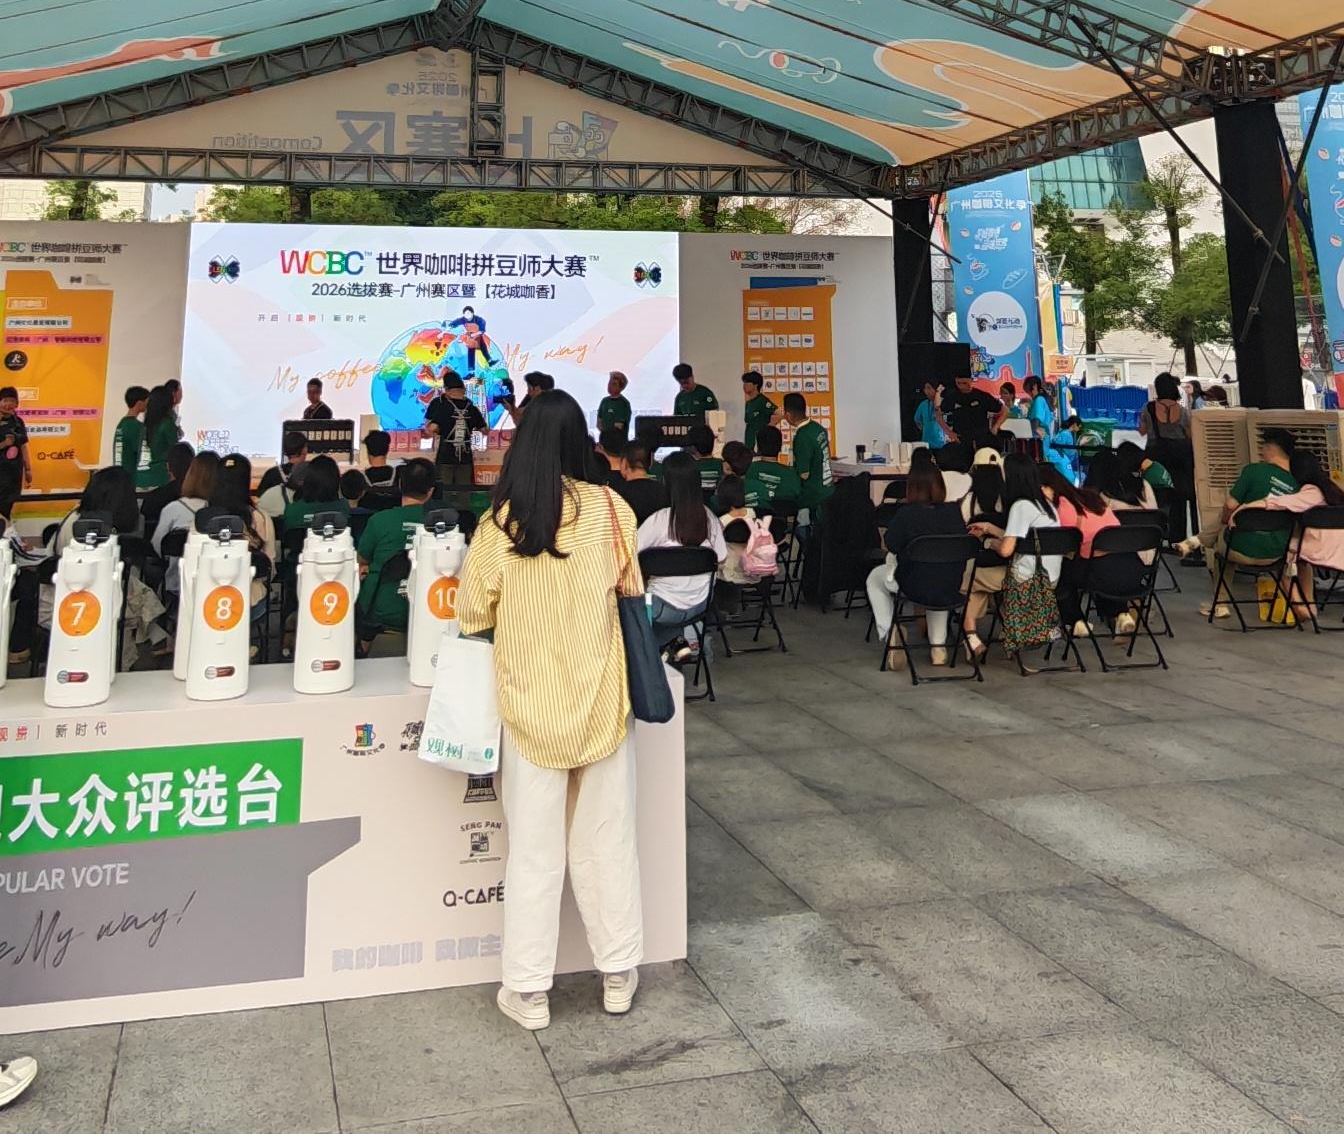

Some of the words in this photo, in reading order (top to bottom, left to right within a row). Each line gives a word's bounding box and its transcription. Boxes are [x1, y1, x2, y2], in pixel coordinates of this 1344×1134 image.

[280, 249, 365, 277] WCBC
[376, 252, 587, 278] 世界咖啡拼豆师大赛
[69, 602, 88, 627] 7
[216, 597, 233, 621] 8
[323, 593, 339, 617] 9
[70, 863, 130, 890] VOTE
